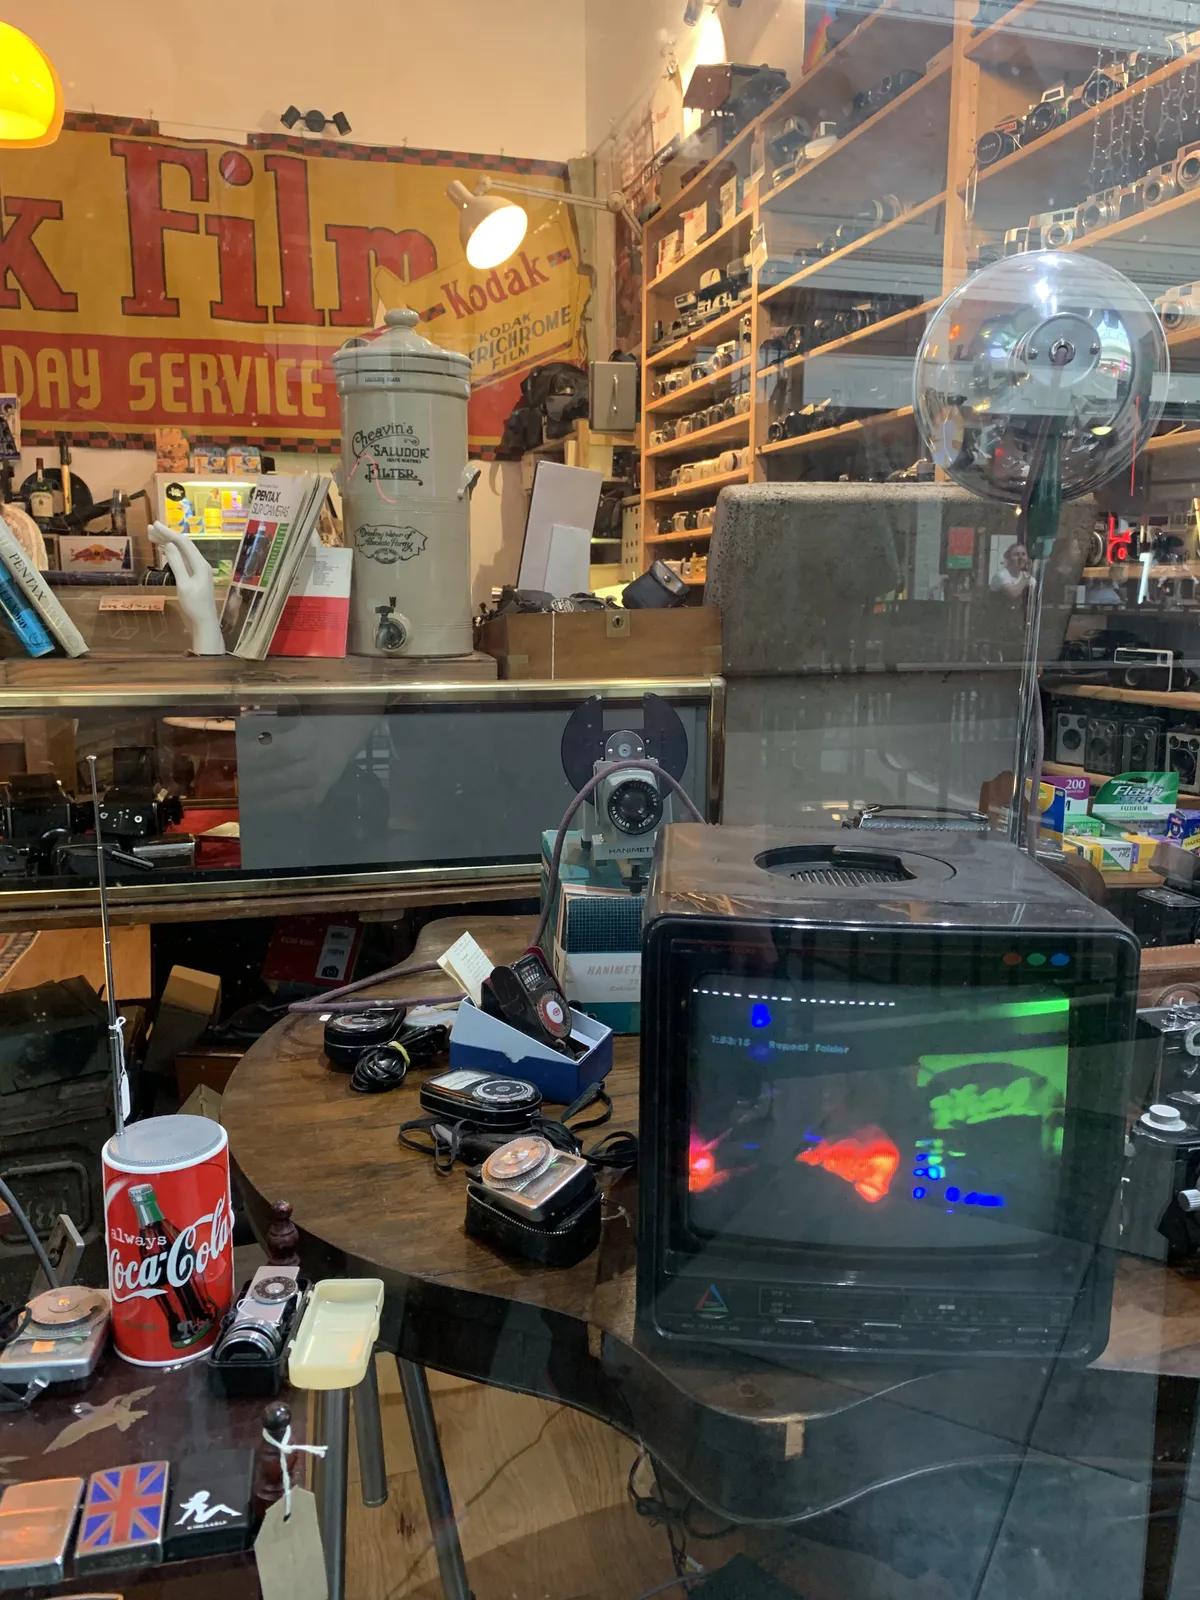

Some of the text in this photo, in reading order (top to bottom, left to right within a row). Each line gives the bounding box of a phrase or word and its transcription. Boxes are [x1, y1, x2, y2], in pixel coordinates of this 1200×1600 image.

[110, 138, 438, 328] Film
[440, 251, 550, 320] Kodak
[467, 304, 571, 366] ERICHROME
[479, 311, 531, 343] KODAK
[492, 343, 530, 370] FILM
[1, 345, 326, 418] DAY SERVICE
[254, 489, 281, 503] PENTAX
[9, 552, 47, 601] PENTAX
[1066, 779, 1086, 790] 200
[1112, 784, 1163, 796] Flash
[110, 1193, 231, 1298] Coca-Cola
[111, 1228, 168, 1250] always
